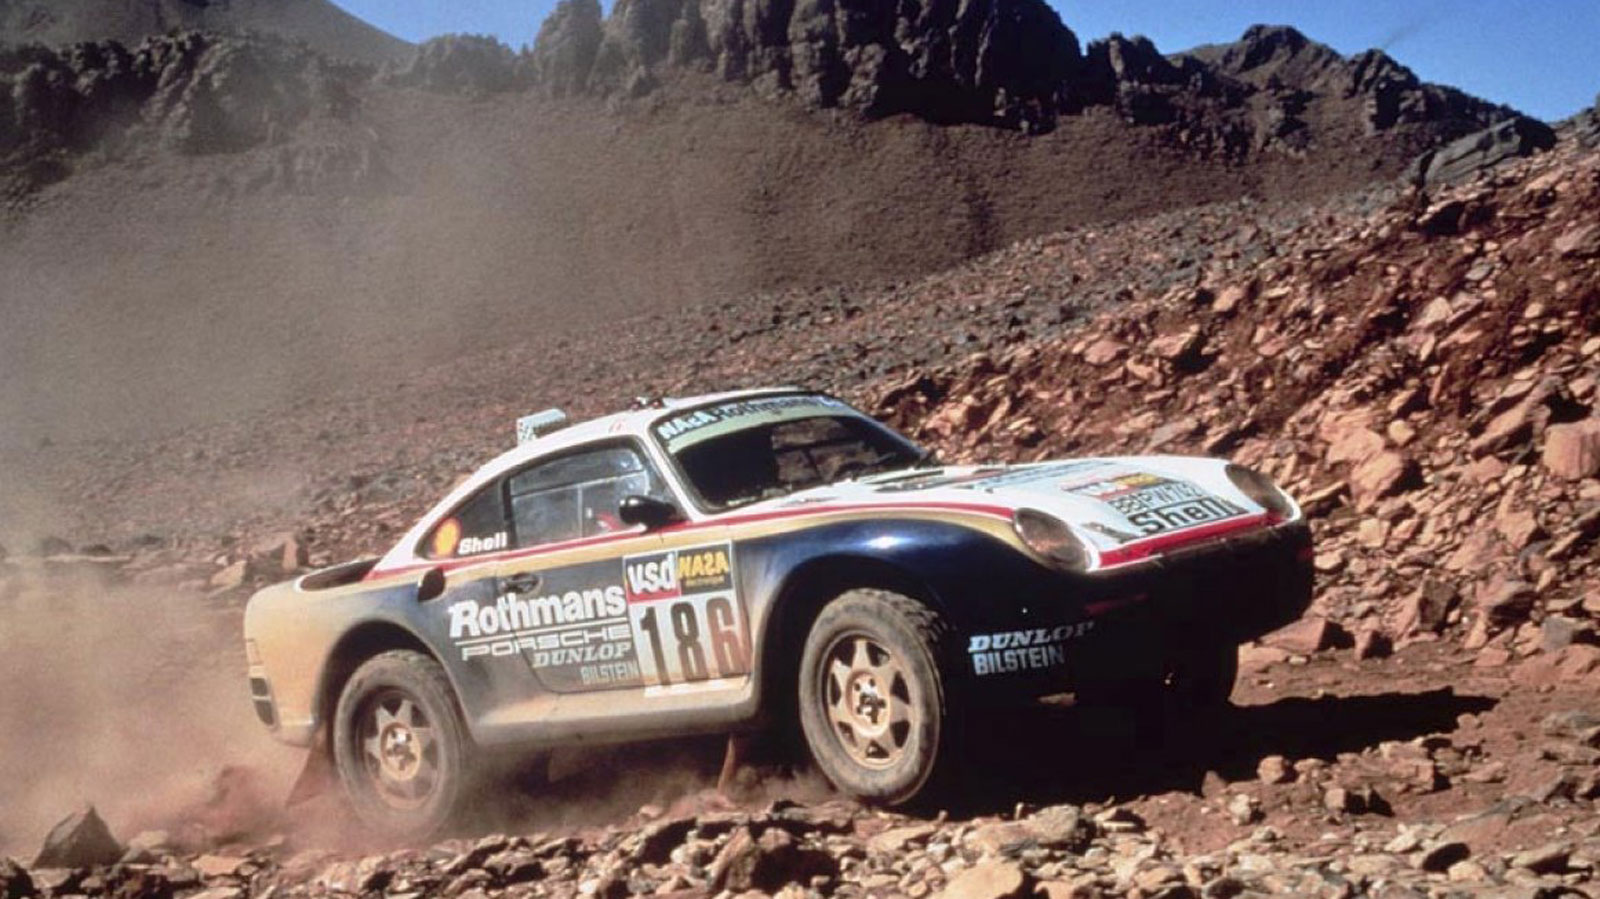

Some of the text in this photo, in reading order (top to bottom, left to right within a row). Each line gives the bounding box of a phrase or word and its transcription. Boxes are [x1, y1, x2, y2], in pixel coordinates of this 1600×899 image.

[1128, 498, 1233, 534] Shell
[458, 531, 508, 555] Shell
[448, 585, 628, 638] Rothmans
[461, 623, 632, 661] PORSCHE
[640, 597, 747, 686] 186
[968, 621, 1094, 653] DUNLOP
[532, 642, 632, 668] DUNLOP
[973, 644, 1065, 676] BILSTEIN
[580, 660, 640, 685] BILSTEIN
